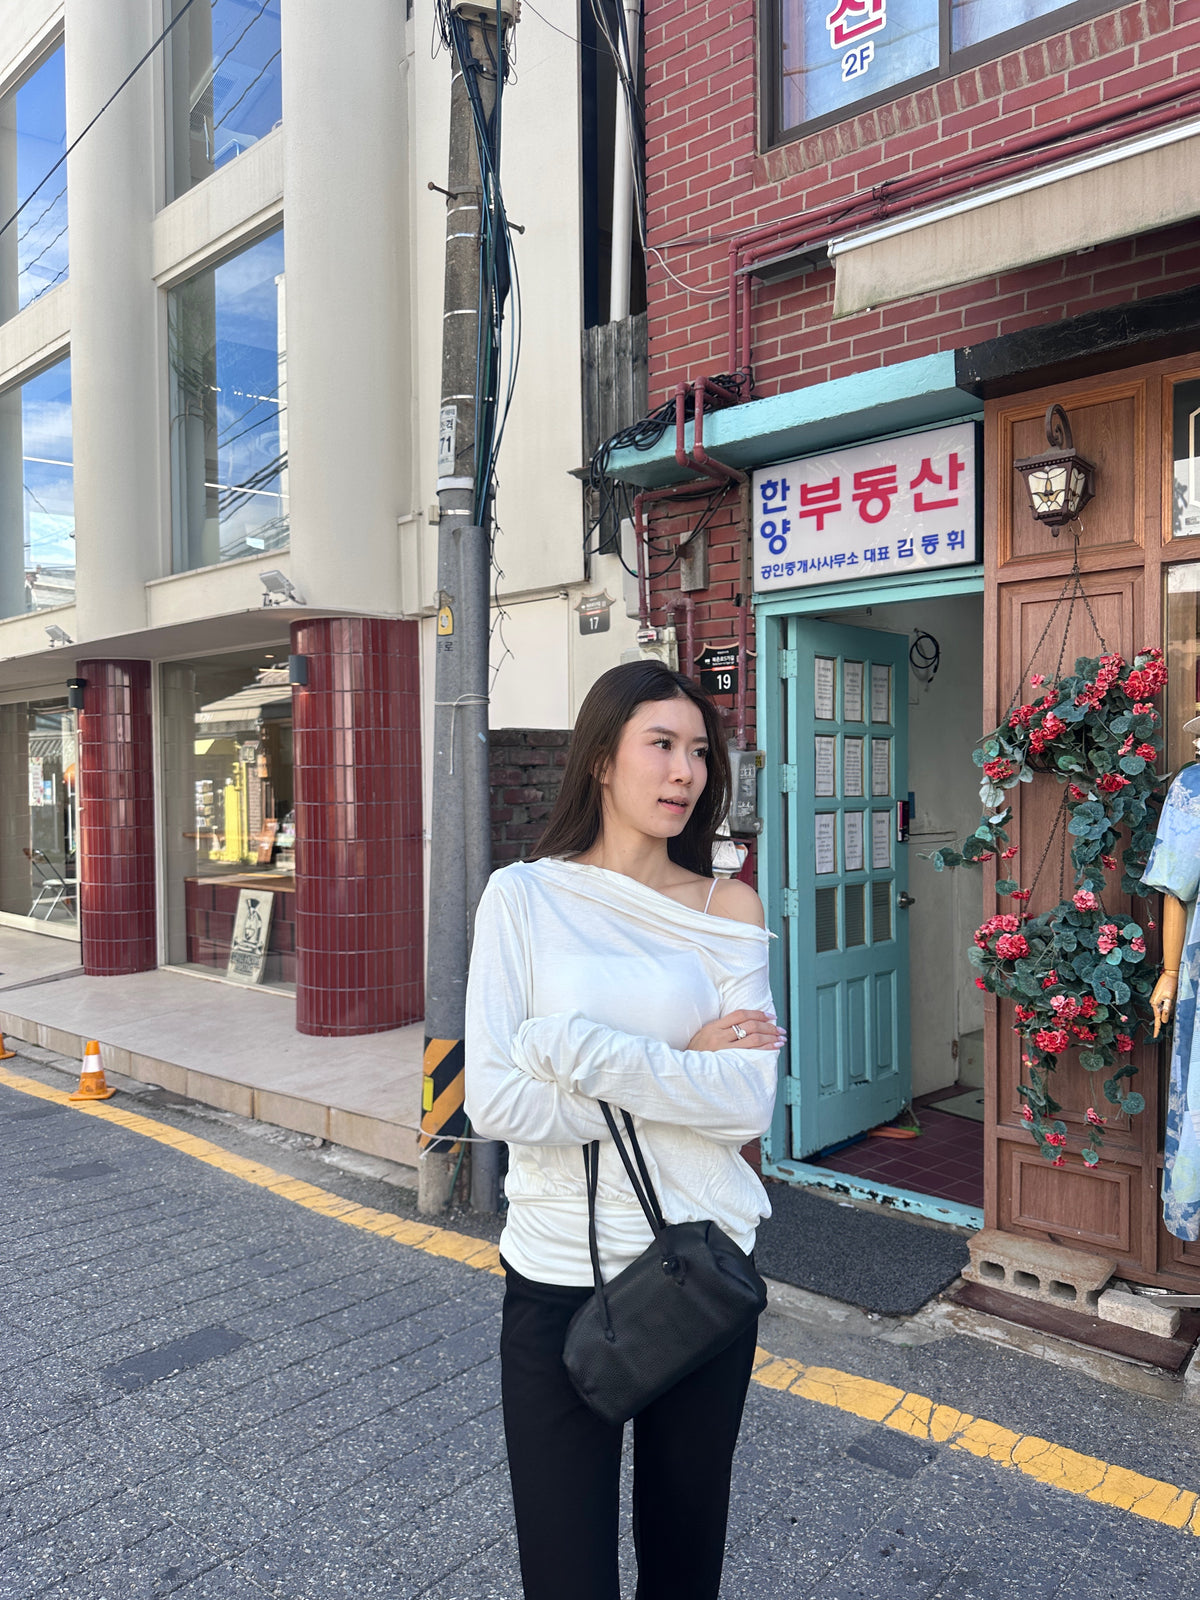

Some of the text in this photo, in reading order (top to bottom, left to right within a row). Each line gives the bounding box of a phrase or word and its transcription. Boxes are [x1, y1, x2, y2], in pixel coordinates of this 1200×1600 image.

[845, 46, 870, 77] 2F
[760, 452, 965, 555] 한양 부동산
[760, 552, 860, 580] 공인중개사사무소
[864, 546, 891, 563] 대표
[589, 616, 600, 630] 17
[716, 673, 731, 690] 19
